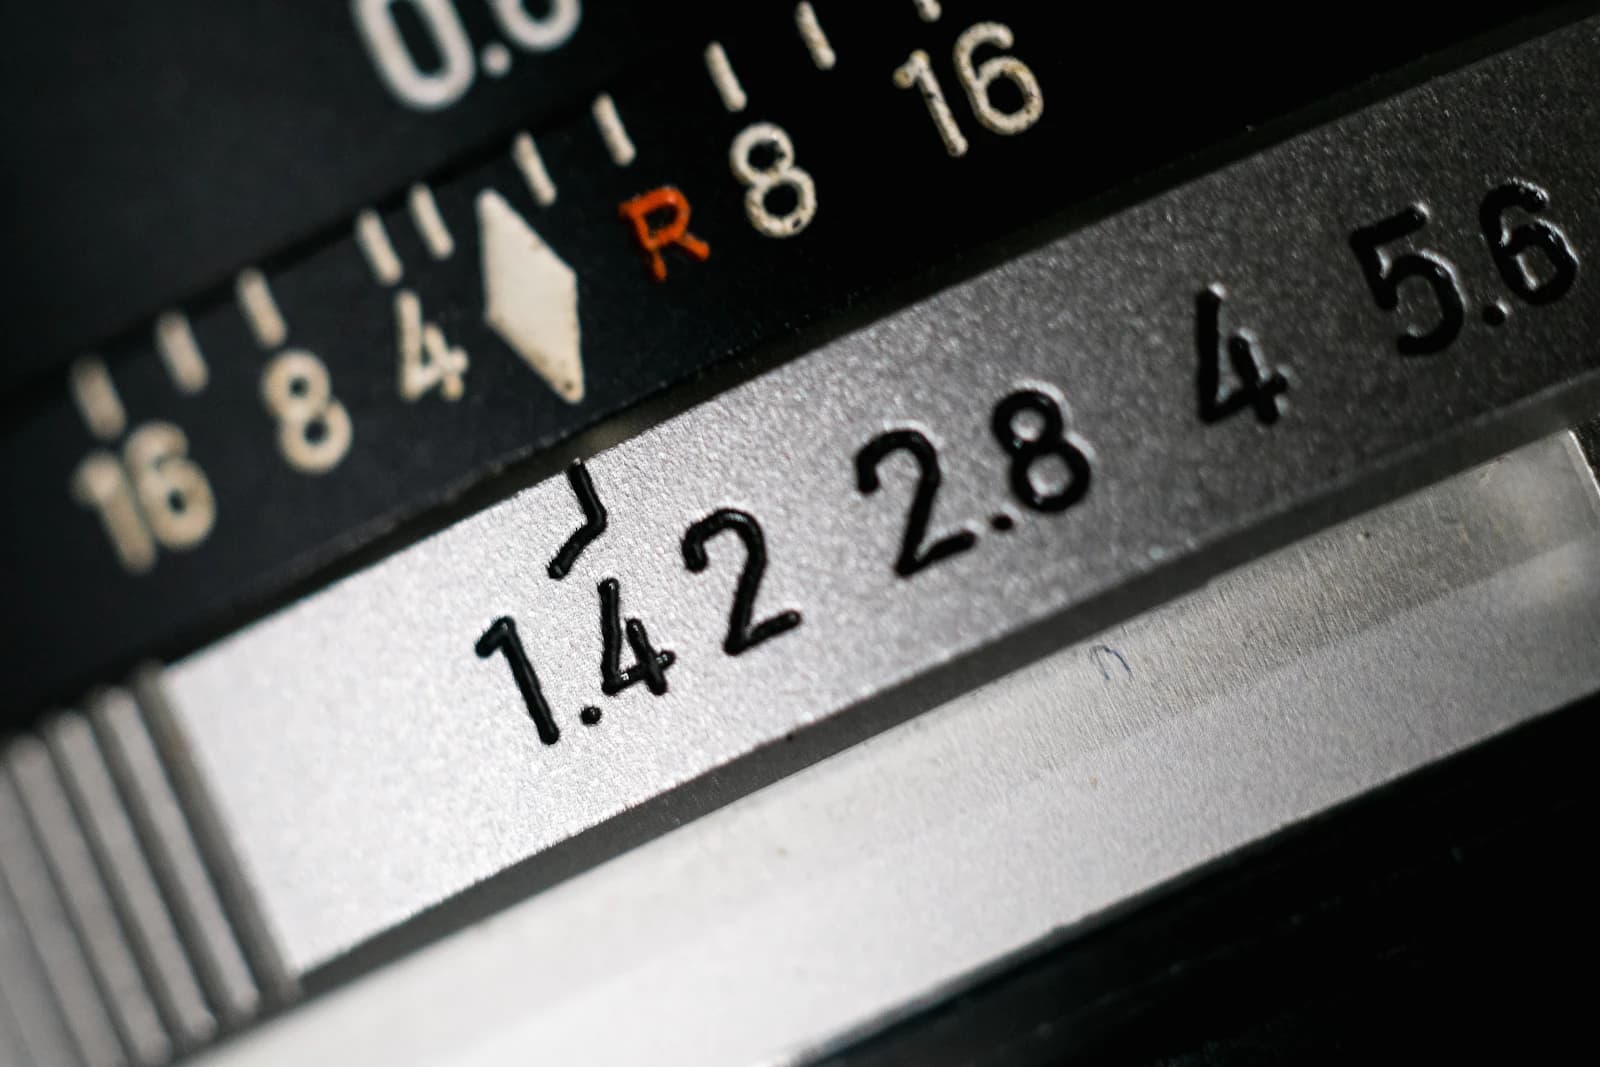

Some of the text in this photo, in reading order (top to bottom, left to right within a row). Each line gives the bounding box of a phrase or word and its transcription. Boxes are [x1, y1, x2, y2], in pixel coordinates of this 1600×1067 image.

[71, 21, 1044, 573] 16 8 4 R 8 16
[475, 178, 1580, 744] 1.4 2 2.8 4 5.6
